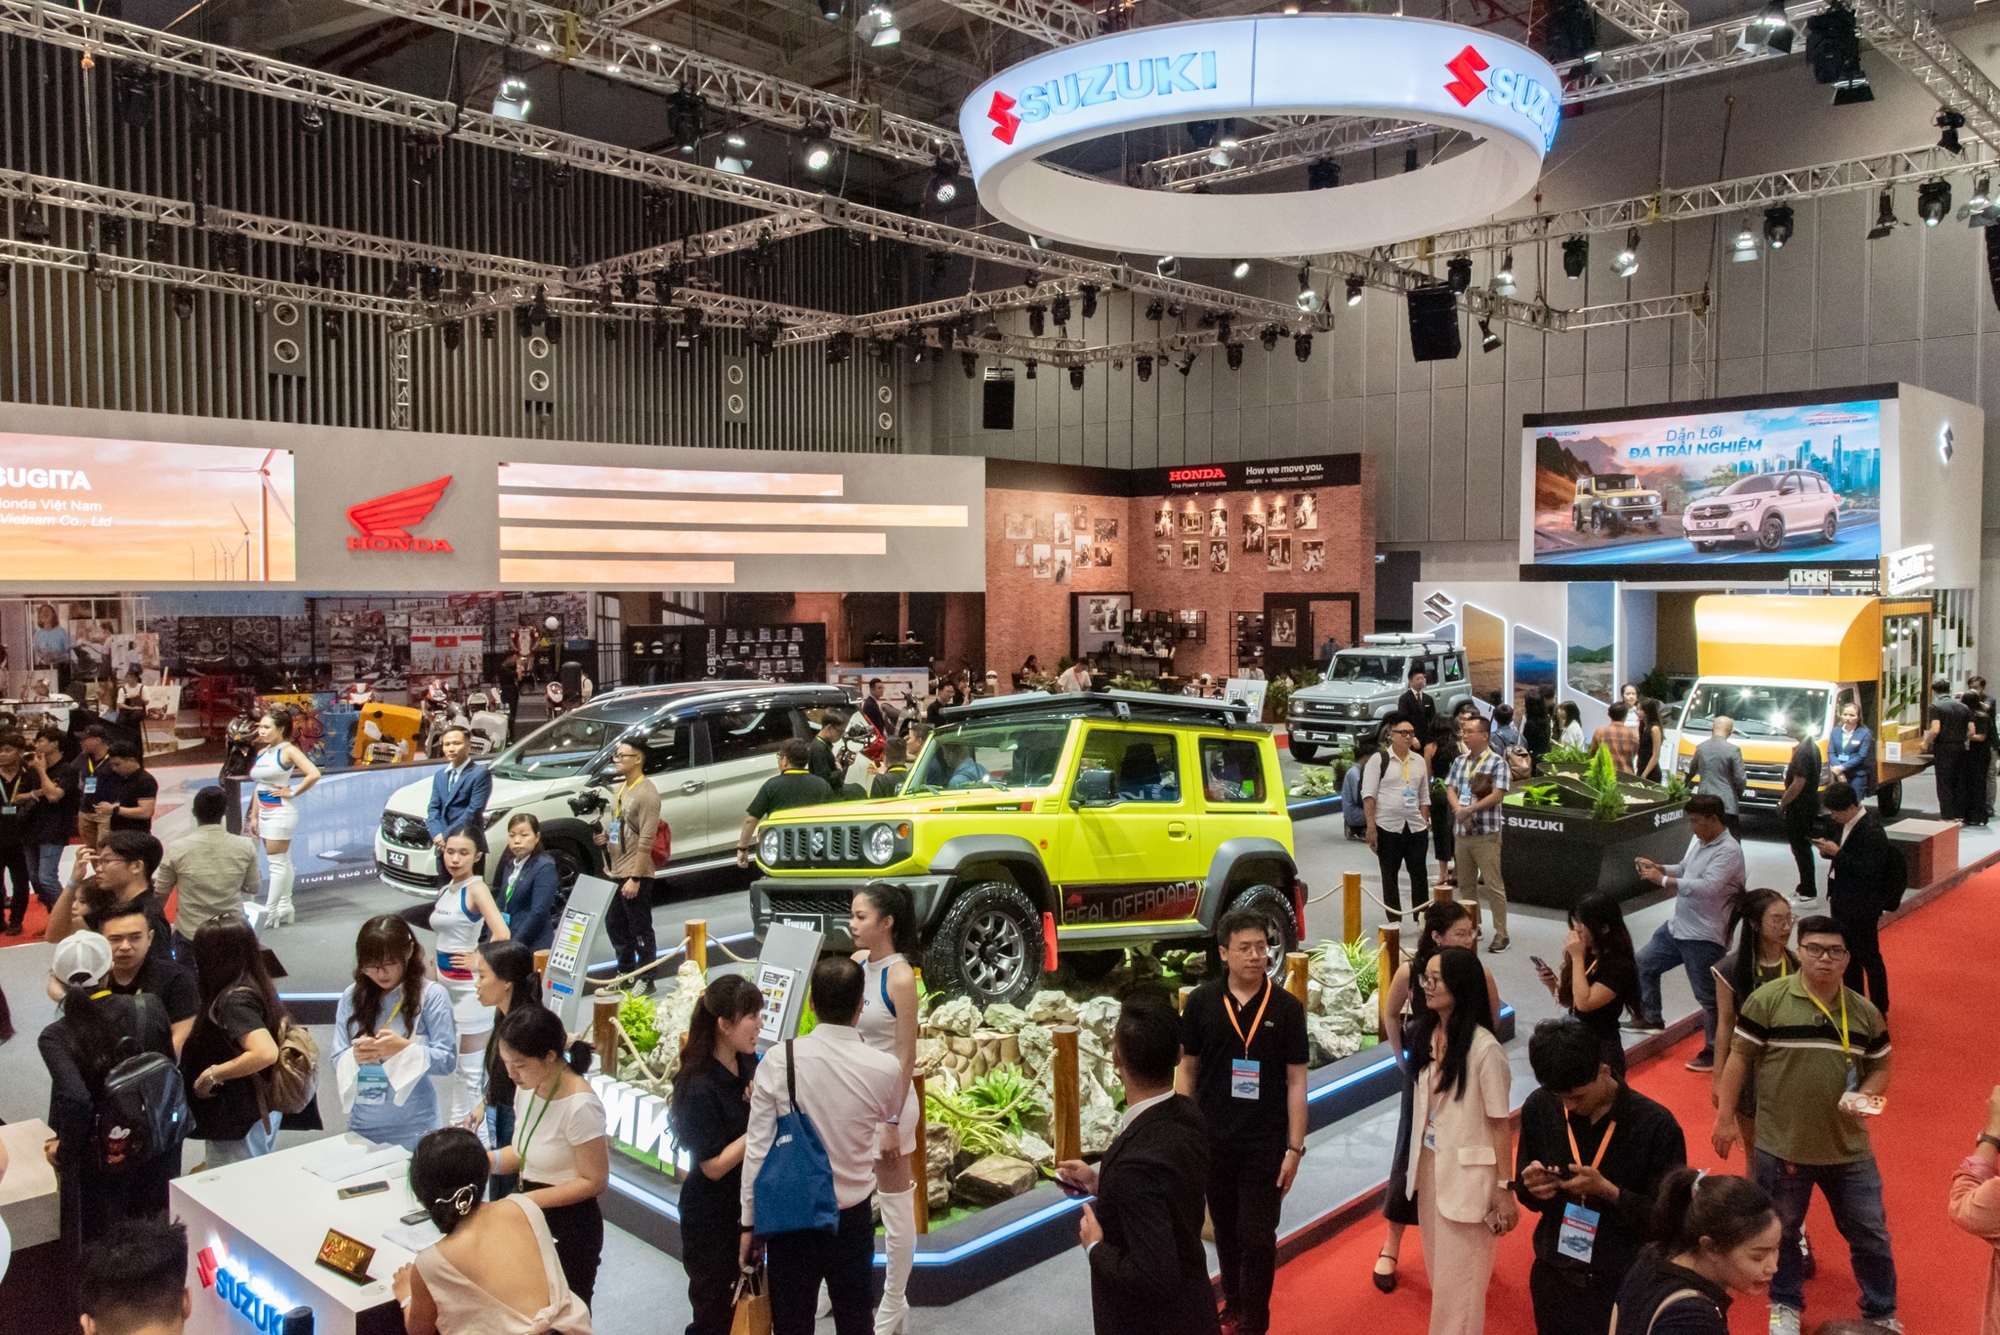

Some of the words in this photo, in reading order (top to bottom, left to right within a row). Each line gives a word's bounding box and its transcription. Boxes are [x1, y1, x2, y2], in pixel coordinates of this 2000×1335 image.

[1020, 51, 1217, 123] SUZUKI
[1700, 426, 1723, 439] Lối
[1628, 446, 1651, 459] ĐA
[1656, 440, 1692, 458] TRẢI
[1696, 437, 1763, 456] NGHIỆM
[1169, 468, 1226, 481] HONDA
[1246, 467, 1265, 475] How
[1281, 465, 1304, 474] move
[1306, 464, 1324, 474] you.
[41, 499, 67, 512] Việt
[71, 500, 102, 512] Nam
[0, 513, 55, 525] Vietnam
[91, 516, 112, 527] Ltd
[347, 536, 454, 552] HONDA
[707, 657, 716, 675] CB
[1661, 809, 1683, 823] SUZUKI
[1508, 816, 1563, 832] SUZUKI
[389, 851, 405, 862] XL7
[216, 1267, 288, 1335] SUZUK
